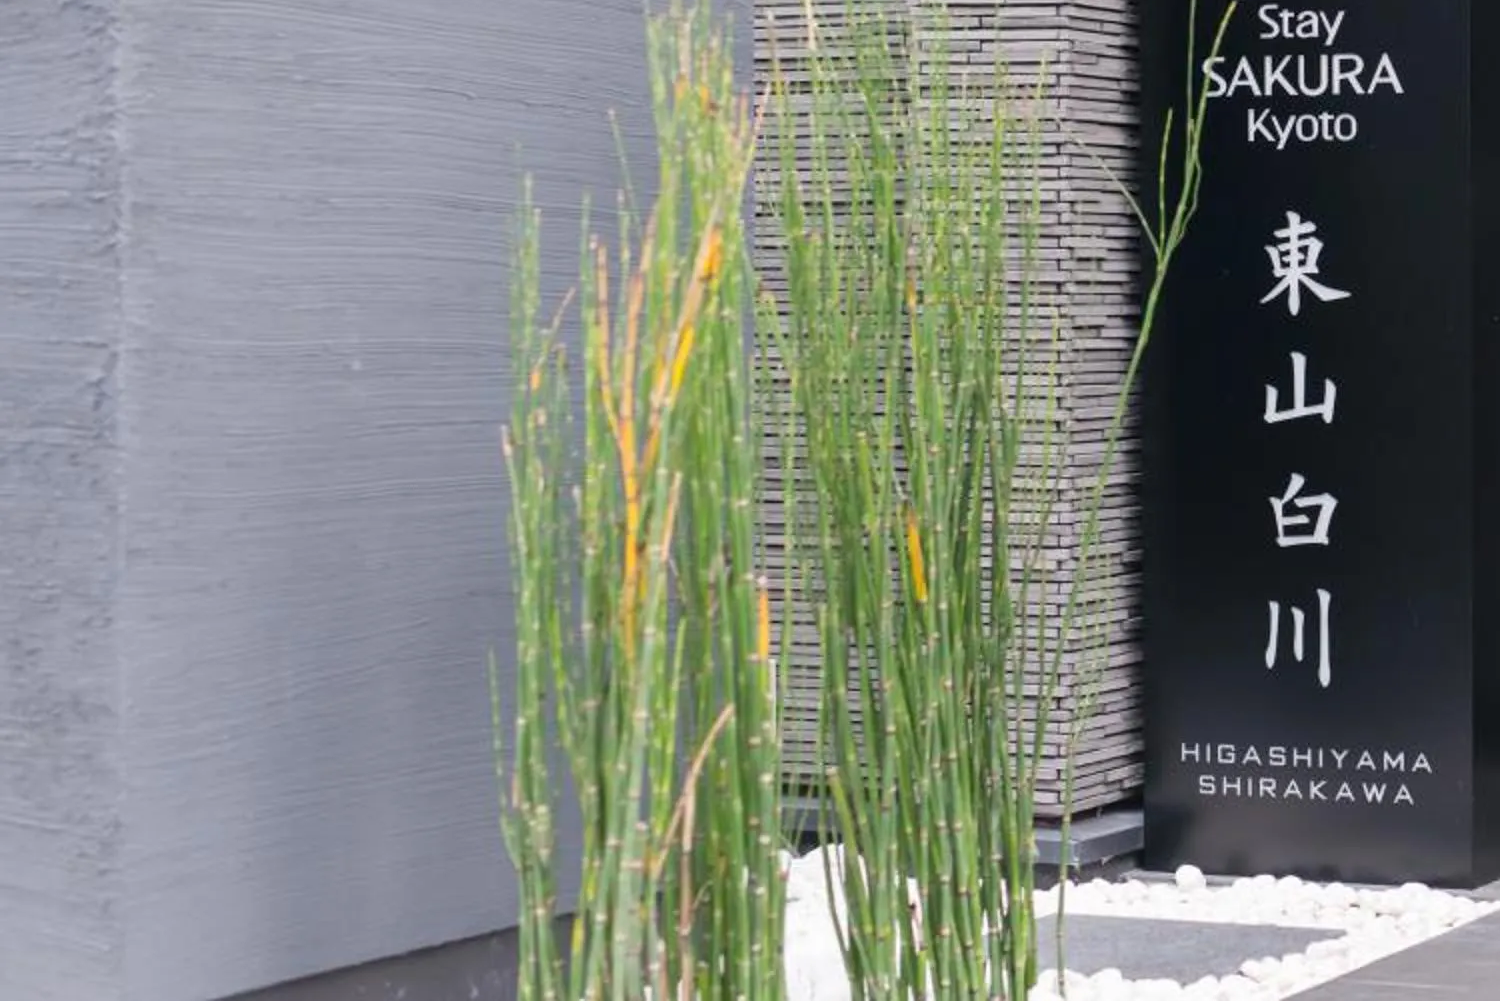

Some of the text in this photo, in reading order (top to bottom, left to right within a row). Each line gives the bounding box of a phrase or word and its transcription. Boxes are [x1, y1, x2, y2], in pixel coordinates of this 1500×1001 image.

[1258, 3, 1345, 46] Stay
[1201, 52, 1405, 97] SAKURA
[1247, 108, 1358, 150] Kyoto
[1259, 210, 1352, 689] 東山白川
[1180, 742, 1433, 774] HIGASHIYAMA
[1199, 774, 1415, 806] SHIRAKAWA
